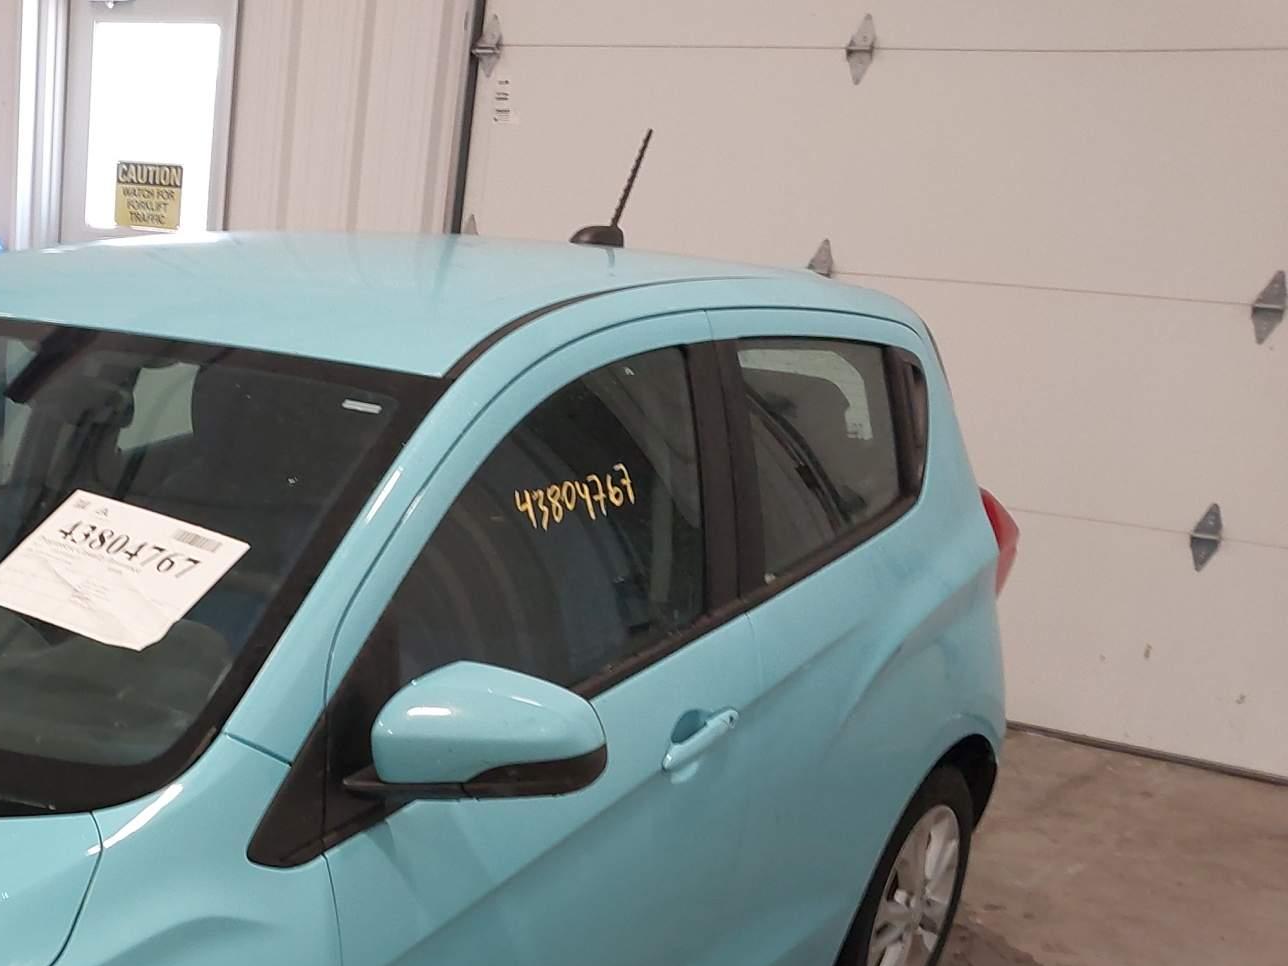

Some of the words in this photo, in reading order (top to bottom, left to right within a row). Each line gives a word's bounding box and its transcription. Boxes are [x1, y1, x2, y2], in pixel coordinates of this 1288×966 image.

[118, 164, 181, 186] CAUTION
[122, 187, 154, 199] WATCH
[157, 189, 175, 201] FOR
[127, 199, 168, 212] FORKLIFT
[129, 211, 166, 224] TRAFFIC
[514, 463, 635, 531] 43804767
[58, 520, 202, 579] 43804767
